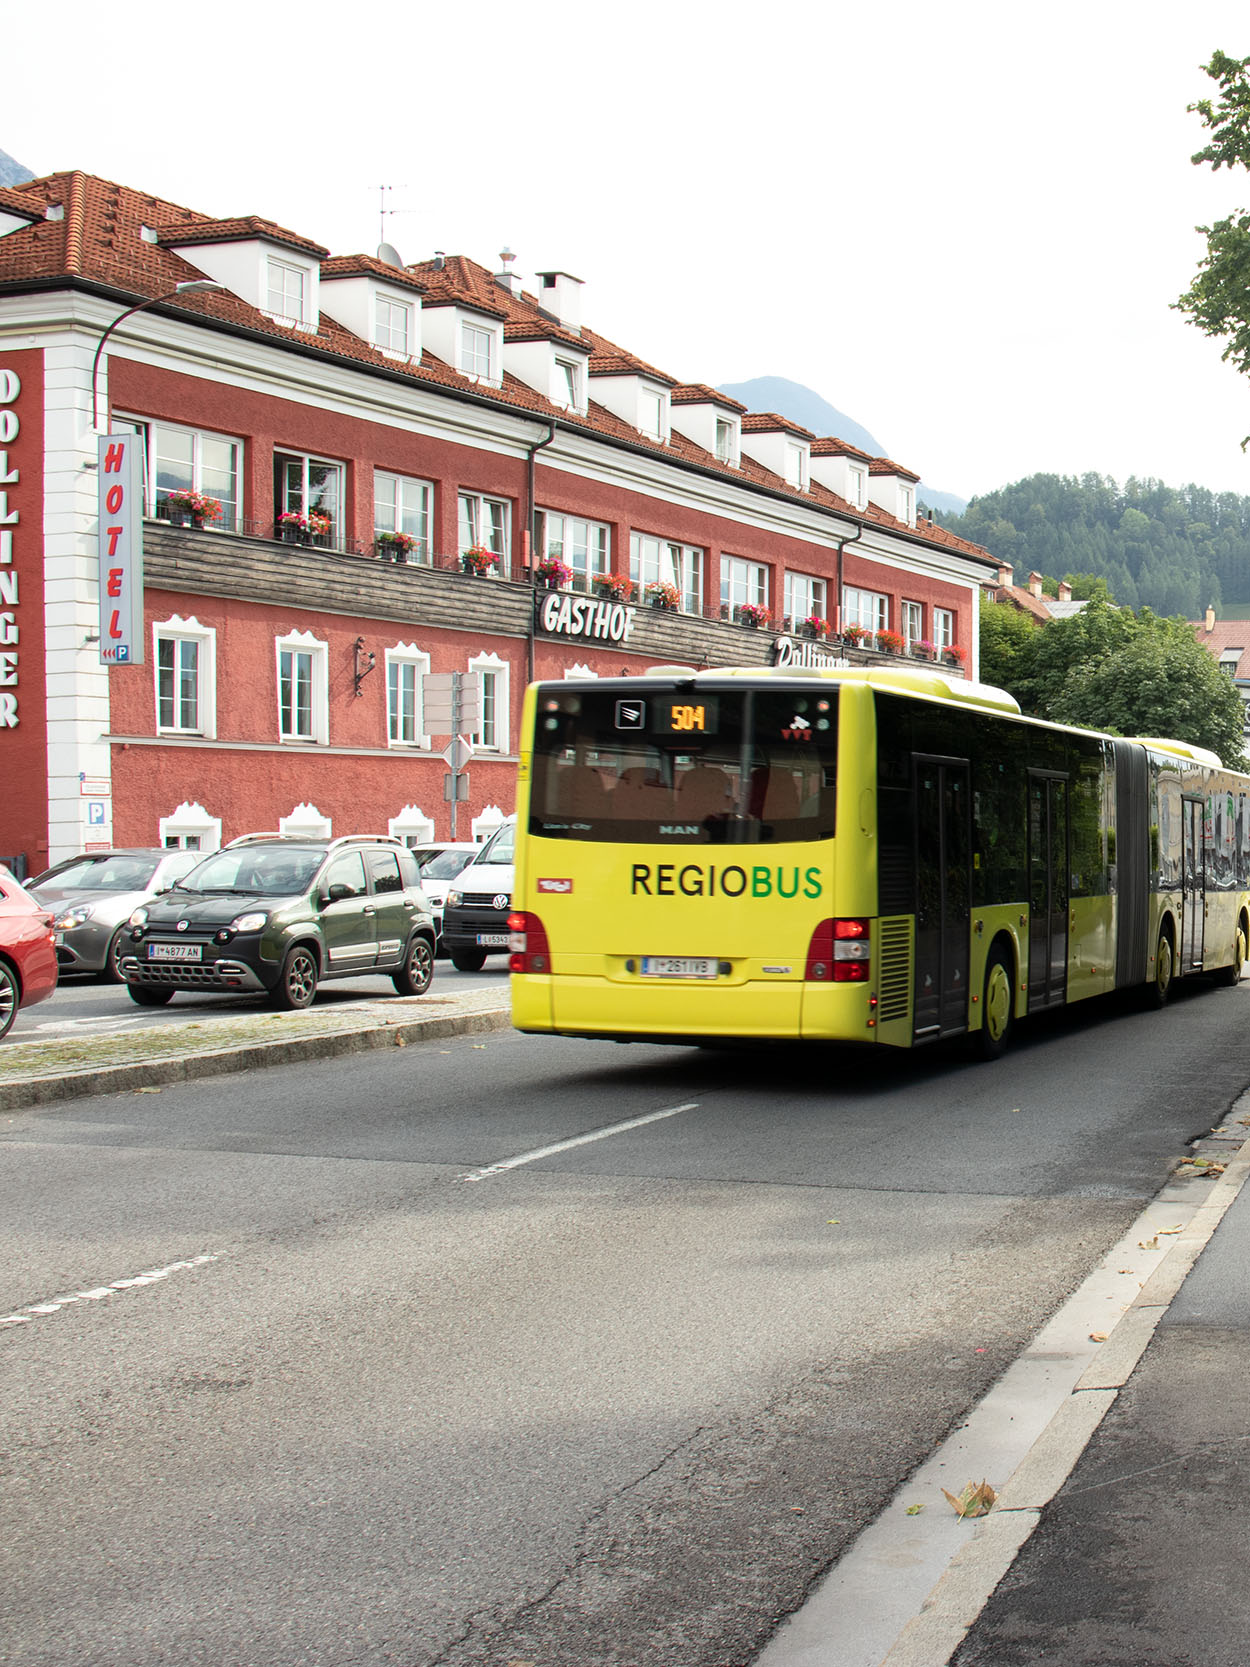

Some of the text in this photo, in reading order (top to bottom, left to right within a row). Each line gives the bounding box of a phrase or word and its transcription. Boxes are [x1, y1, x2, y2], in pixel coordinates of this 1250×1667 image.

[104, 443, 125, 639] HOTEL
[542, 593, 637, 642] GASTHOF
[671, 705, 705, 731] 504
[90, 803, 104, 823] P
[659, 825, 699, 835] MAN
[630, 864, 822, 899] REGIOBUS
